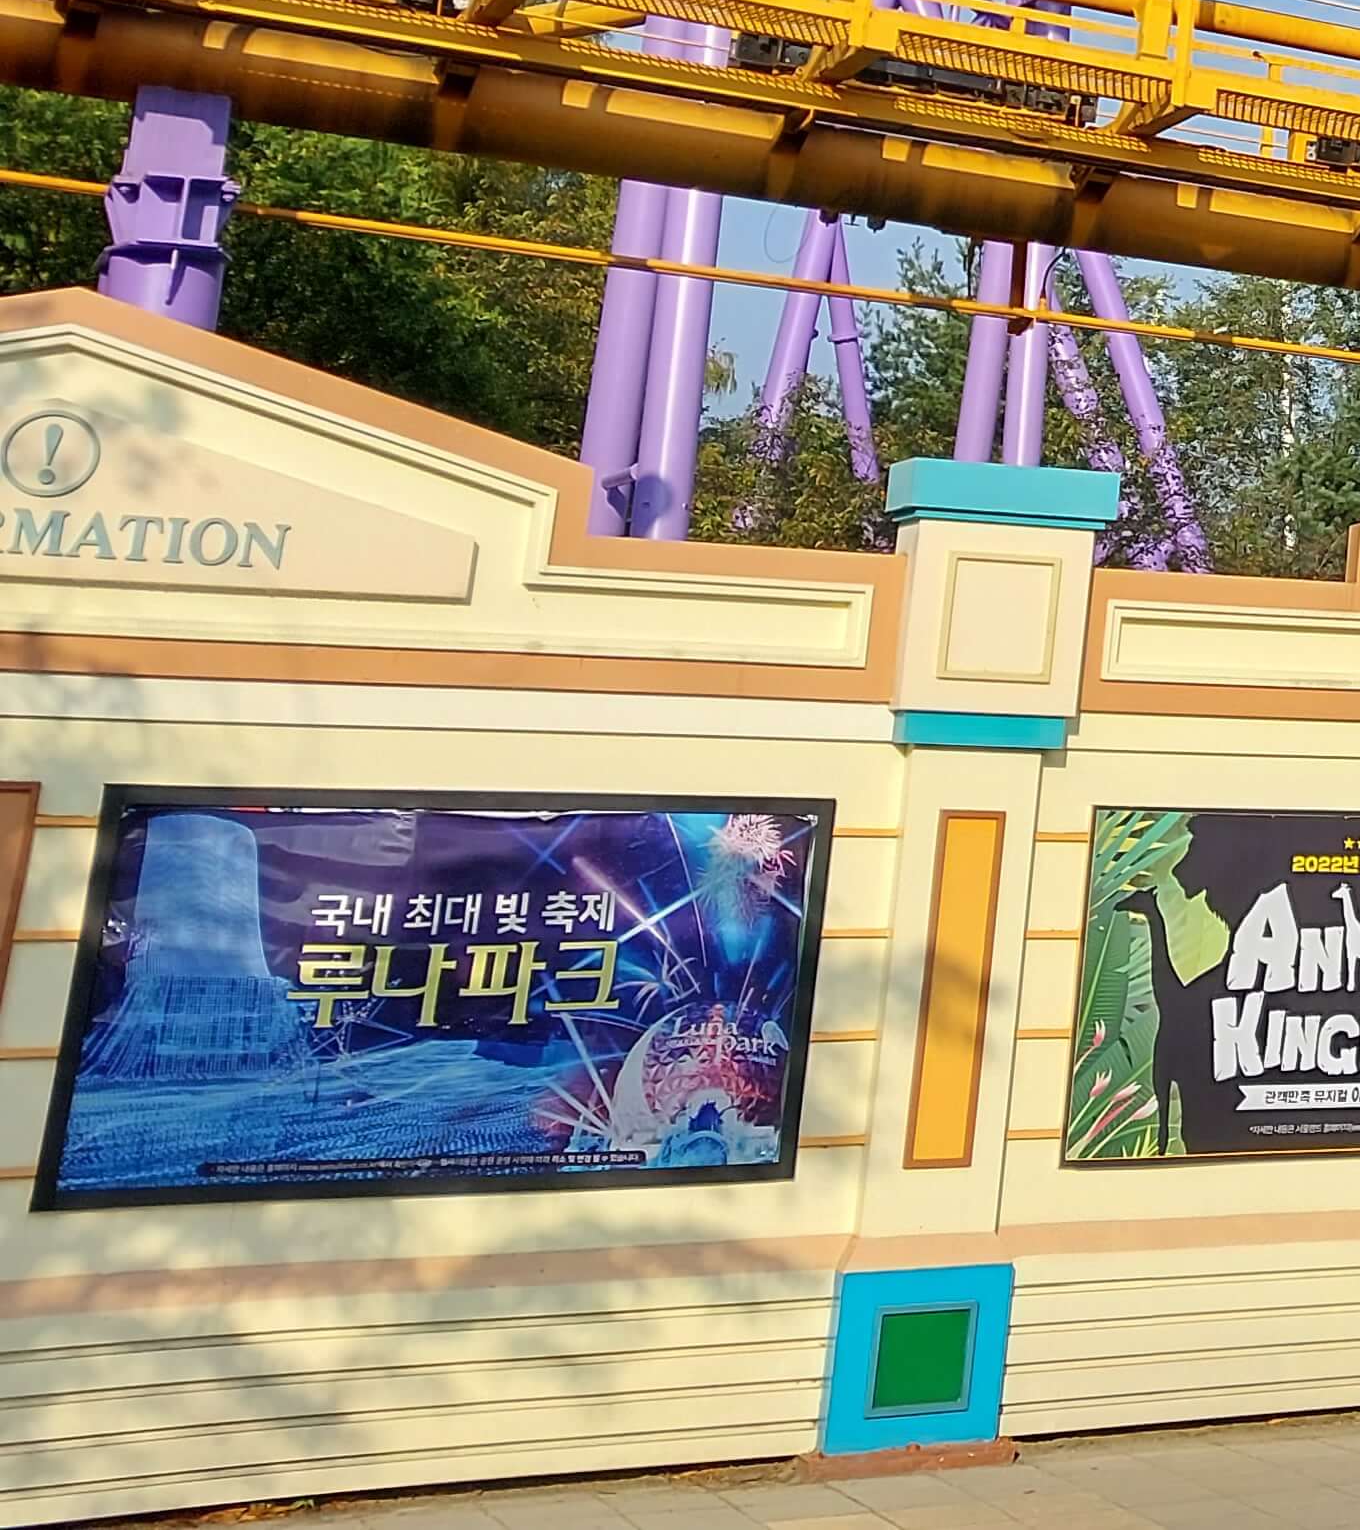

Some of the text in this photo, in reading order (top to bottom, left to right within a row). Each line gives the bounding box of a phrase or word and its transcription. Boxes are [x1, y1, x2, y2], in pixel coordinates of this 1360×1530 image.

[0, 507, 292, 571] MATION
[1291, 855, 1360, 874] 2022년
[311, 890, 617, 937] 국내 최대 빛 축제
[286, 939, 621, 1029] 루나파크
[1313, 1089, 1348, 1104] 뮤지컬
